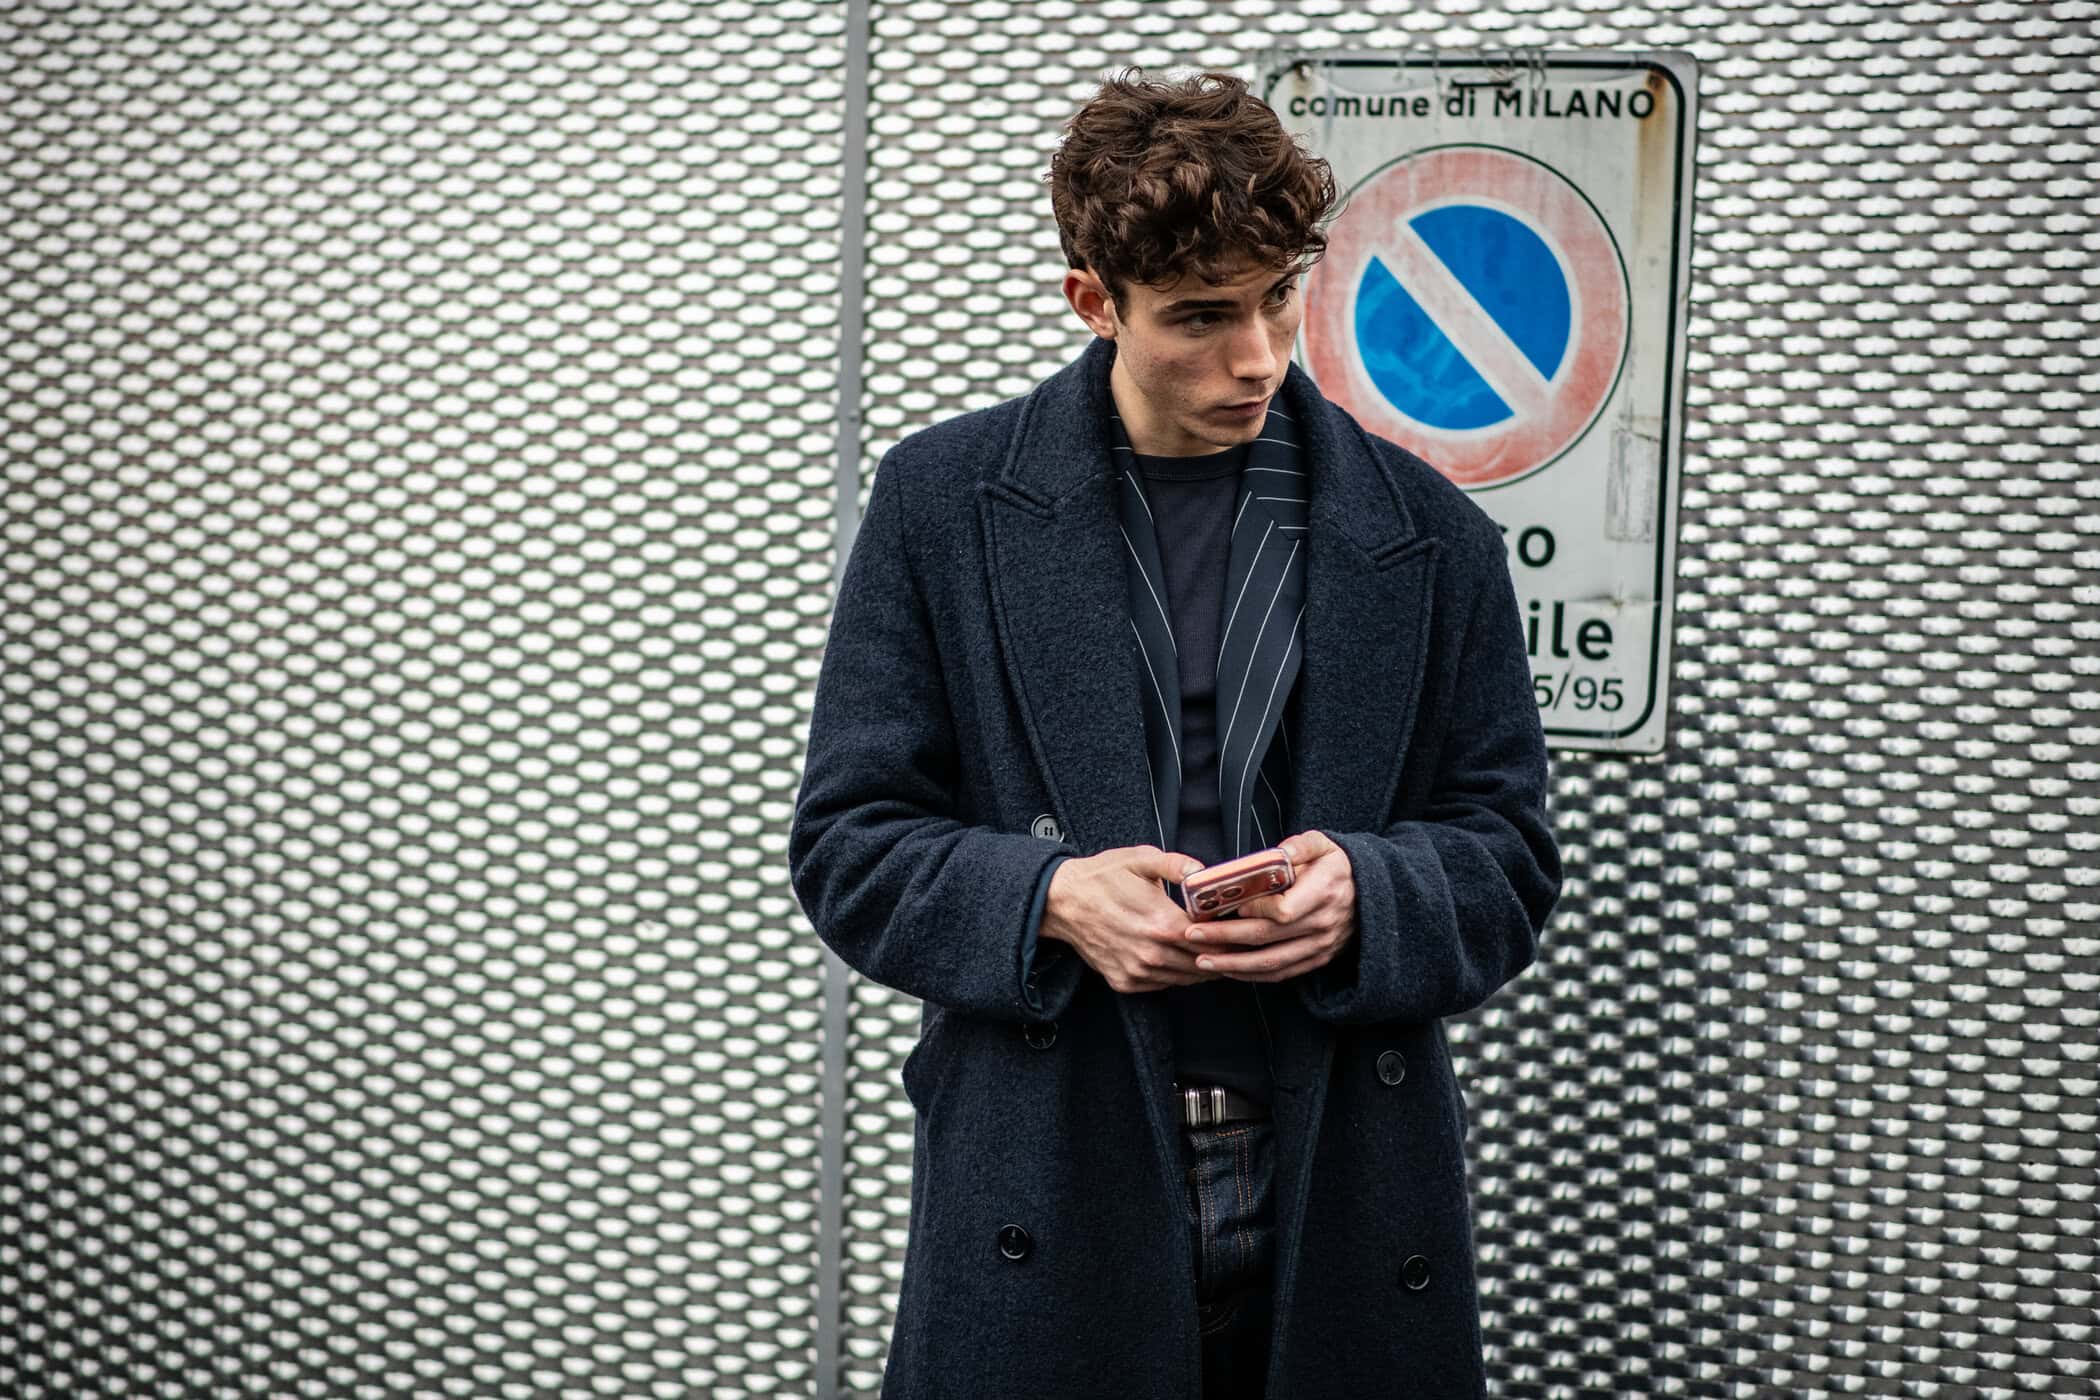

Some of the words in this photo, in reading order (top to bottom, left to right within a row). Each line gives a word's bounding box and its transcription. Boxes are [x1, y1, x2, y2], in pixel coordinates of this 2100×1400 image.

[1289, 96, 1430, 117] comune
[1445, 86, 1476, 117] di
[1493, 88, 1656, 119] MILANO
[1500, 525, 1556, 568] o
[1527, 600, 1614, 661] ile
